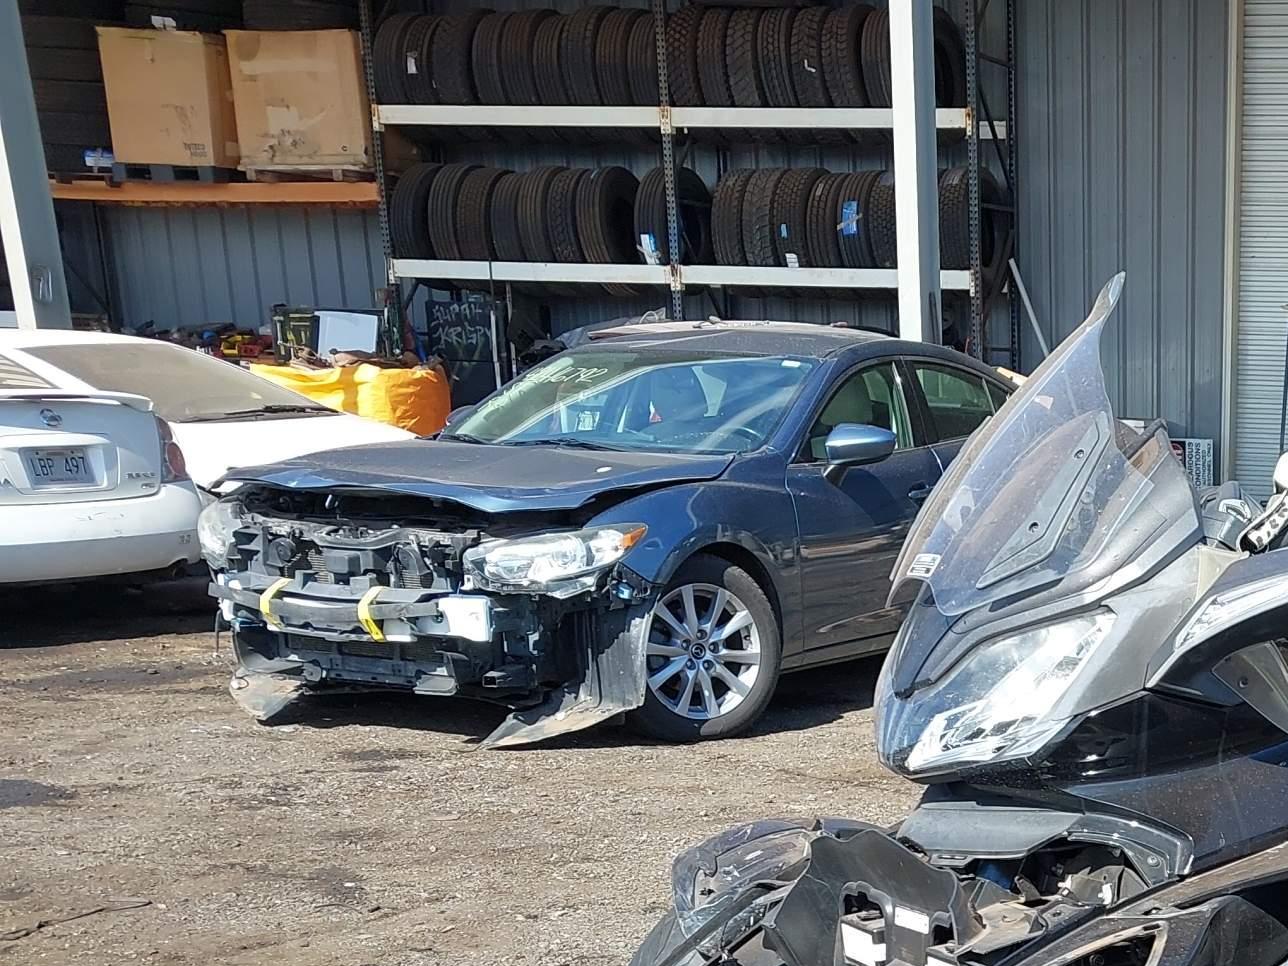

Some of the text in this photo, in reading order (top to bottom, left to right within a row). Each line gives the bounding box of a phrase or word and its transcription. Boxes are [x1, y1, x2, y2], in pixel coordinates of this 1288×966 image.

[30, 456, 89, 477] LBP 497
[1194, 442, 1202, 489] ONDITIONS
